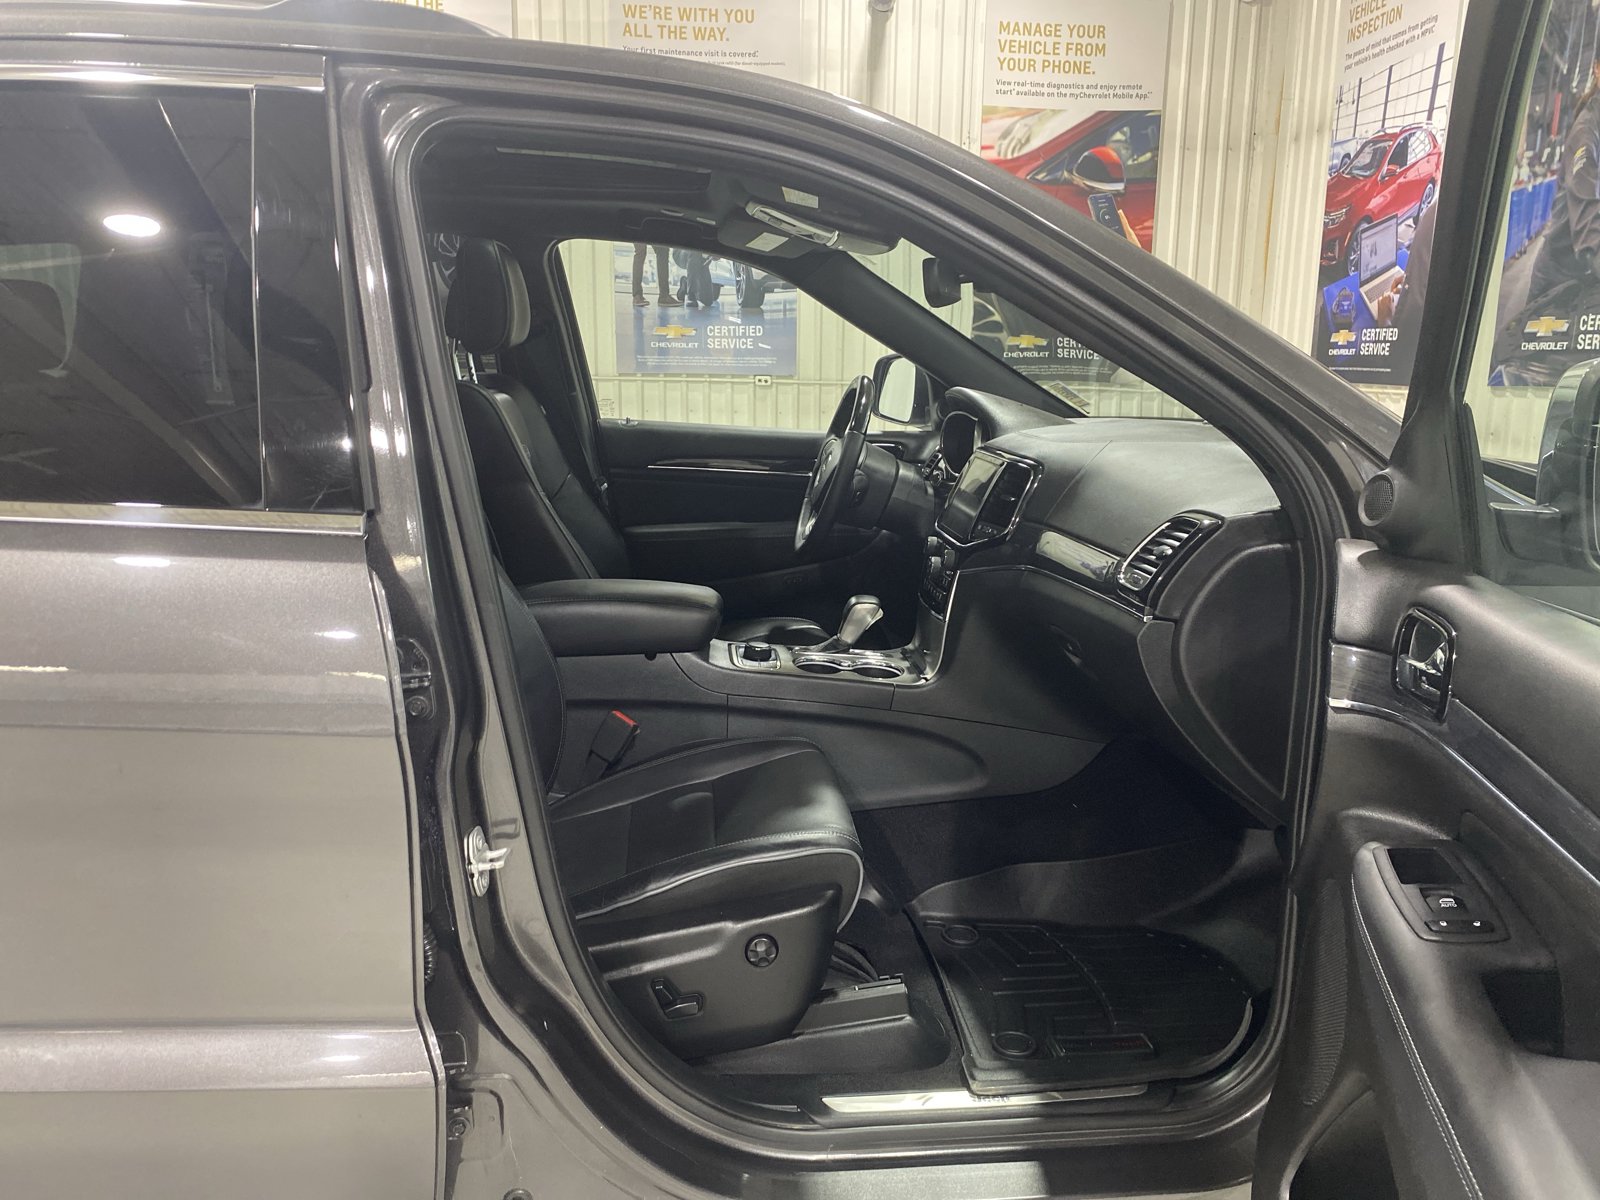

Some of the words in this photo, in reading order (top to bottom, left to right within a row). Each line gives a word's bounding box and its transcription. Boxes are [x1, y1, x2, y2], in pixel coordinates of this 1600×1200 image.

[623, 4, 672, 21] WE'RE
[678, 7, 718, 23] WITH
[724, 9, 755, 24] YOU
[998, 21, 1063, 38] MANAGE
[1067, 24, 1106, 39] YOUR
[1347, 4, 1403, 44] INSPECTION
[623, 23, 653, 38] ALL
[657, 25, 688, 40] THE
[693, 26, 730, 42] WAY.
[1371, 40, 1382, 49] mind
[1391, 29, 1407, 41] comes
[1407, 23, 1420, 34] from
[657, 48, 703, 57] maintenance
[997, 39, 1061, 56] VEHICLE
[1065, 42, 1107, 57] FROM
[997, 57, 1037, 73] YOUR
[1041, 60, 1096, 75] PHONE.
[1013, 80, 1045, 88] real-time
[1046, 81, 1084, 90] diagnostics
[1100, 83, 1118, 91] enjoy
[1016, 89, 1045, 97] available
[1068, 91, 1111, 100] myChevrolet
[707, 325, 763, 337] CERTIFIED
[1361, 327, 1399, 341] CERTIFIED
[650, 341, 699, 349] CHEVROLET
[707, 338, 754, 349] SERVICE
[1360, 342, 1391, 356] SERVICE
[1521, 341, 1569, 351] CHEVROLET
[1003, 350, 1050, 358] CHEVROLET
[1057, 348, 1100, 360] SERVICE
[1328, 348, 1357, 356] CHEVROLET
